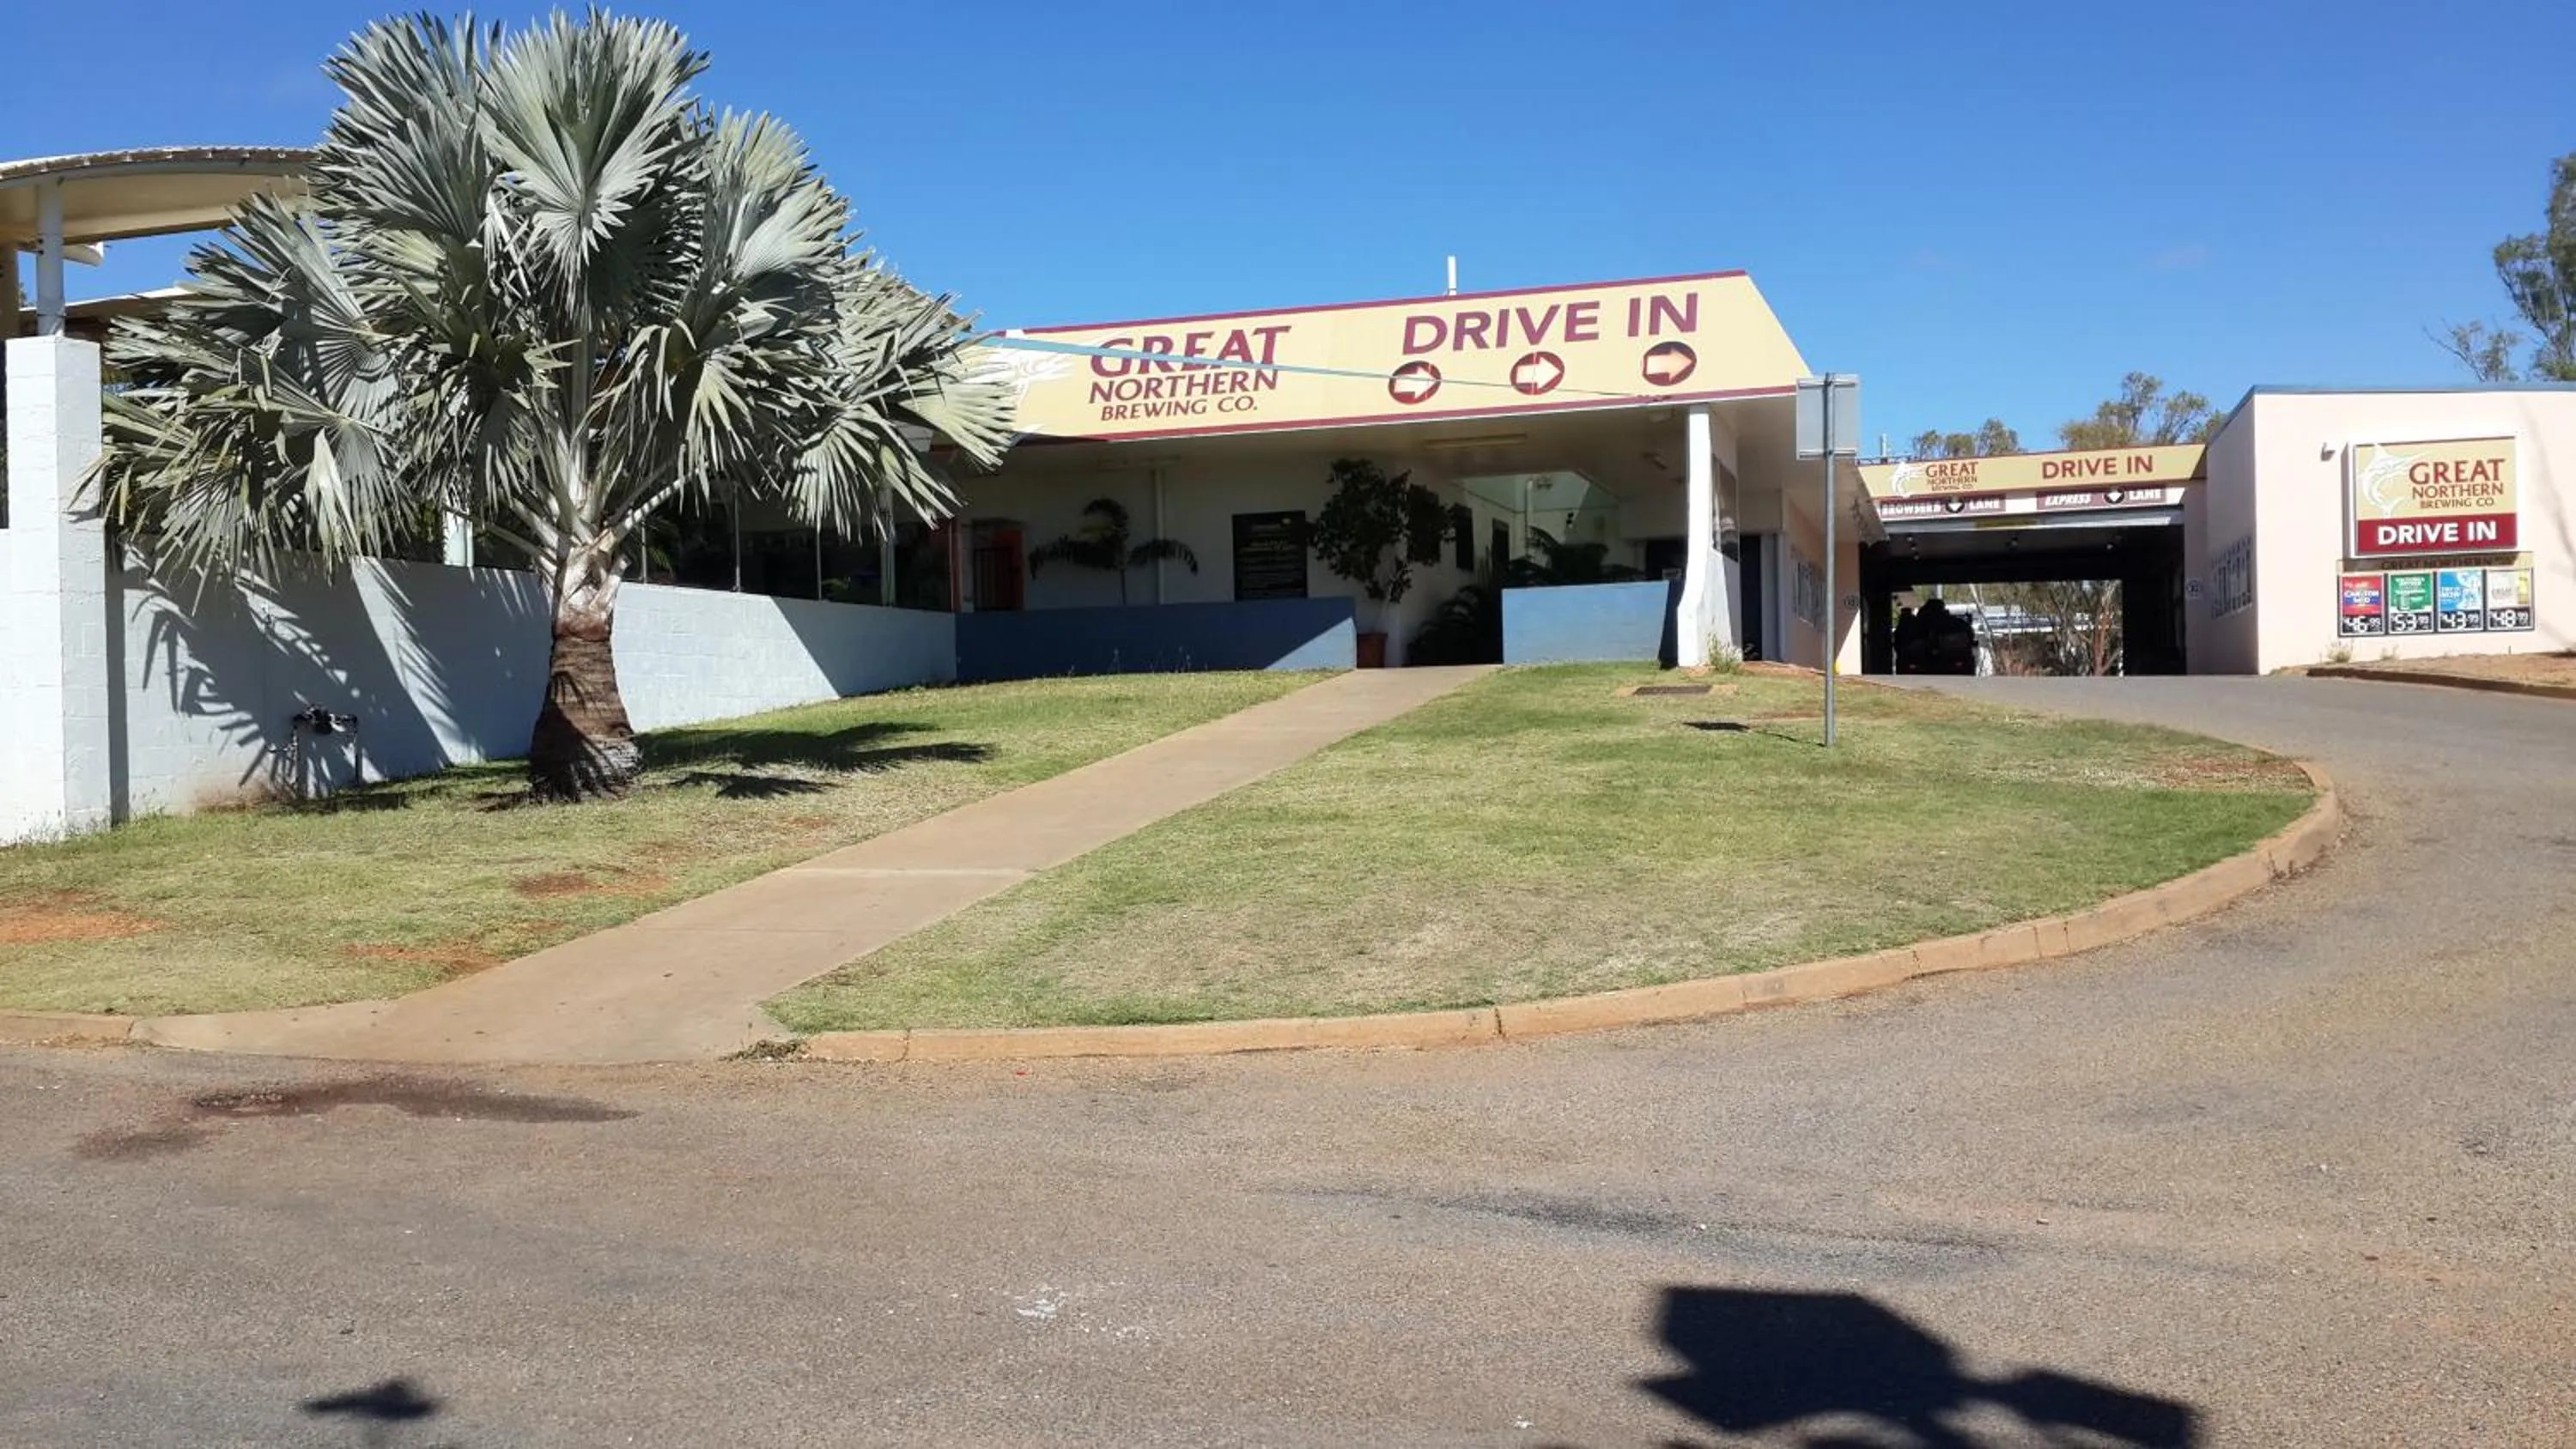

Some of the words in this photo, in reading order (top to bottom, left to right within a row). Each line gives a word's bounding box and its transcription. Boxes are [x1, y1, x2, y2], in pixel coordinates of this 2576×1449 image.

[1402, 301, 1601, 355] DRIVE
[1627, 293, 1698, 336] IN
[1091, 326, 1291, 377] GREAT
[1089, 369, 1278, 403] NORTHERN
[1101, 398, 1207, 421] BREWING
[1218, 396, 1258, 413] CO.
[1925, 461, 1978, 478] GREAT
[2041, 458, 2118, 480] DRIVE
[2126, 455, 2154, 475] IN
[2409, 458, 2506, 485] GREAT
[2044, 493, 2092, 506] EXPRESS
[2129, 488, 2161, 500] LANE
[2411, 482, 2504, 500] NORTHERN
[1969, 499, 2001, 511] LANE
[2420, 498, 2472, 509] BREWING
[2377, 522, 2459, 545] DRIVE
[2468, 521, 2497, 541] IN
